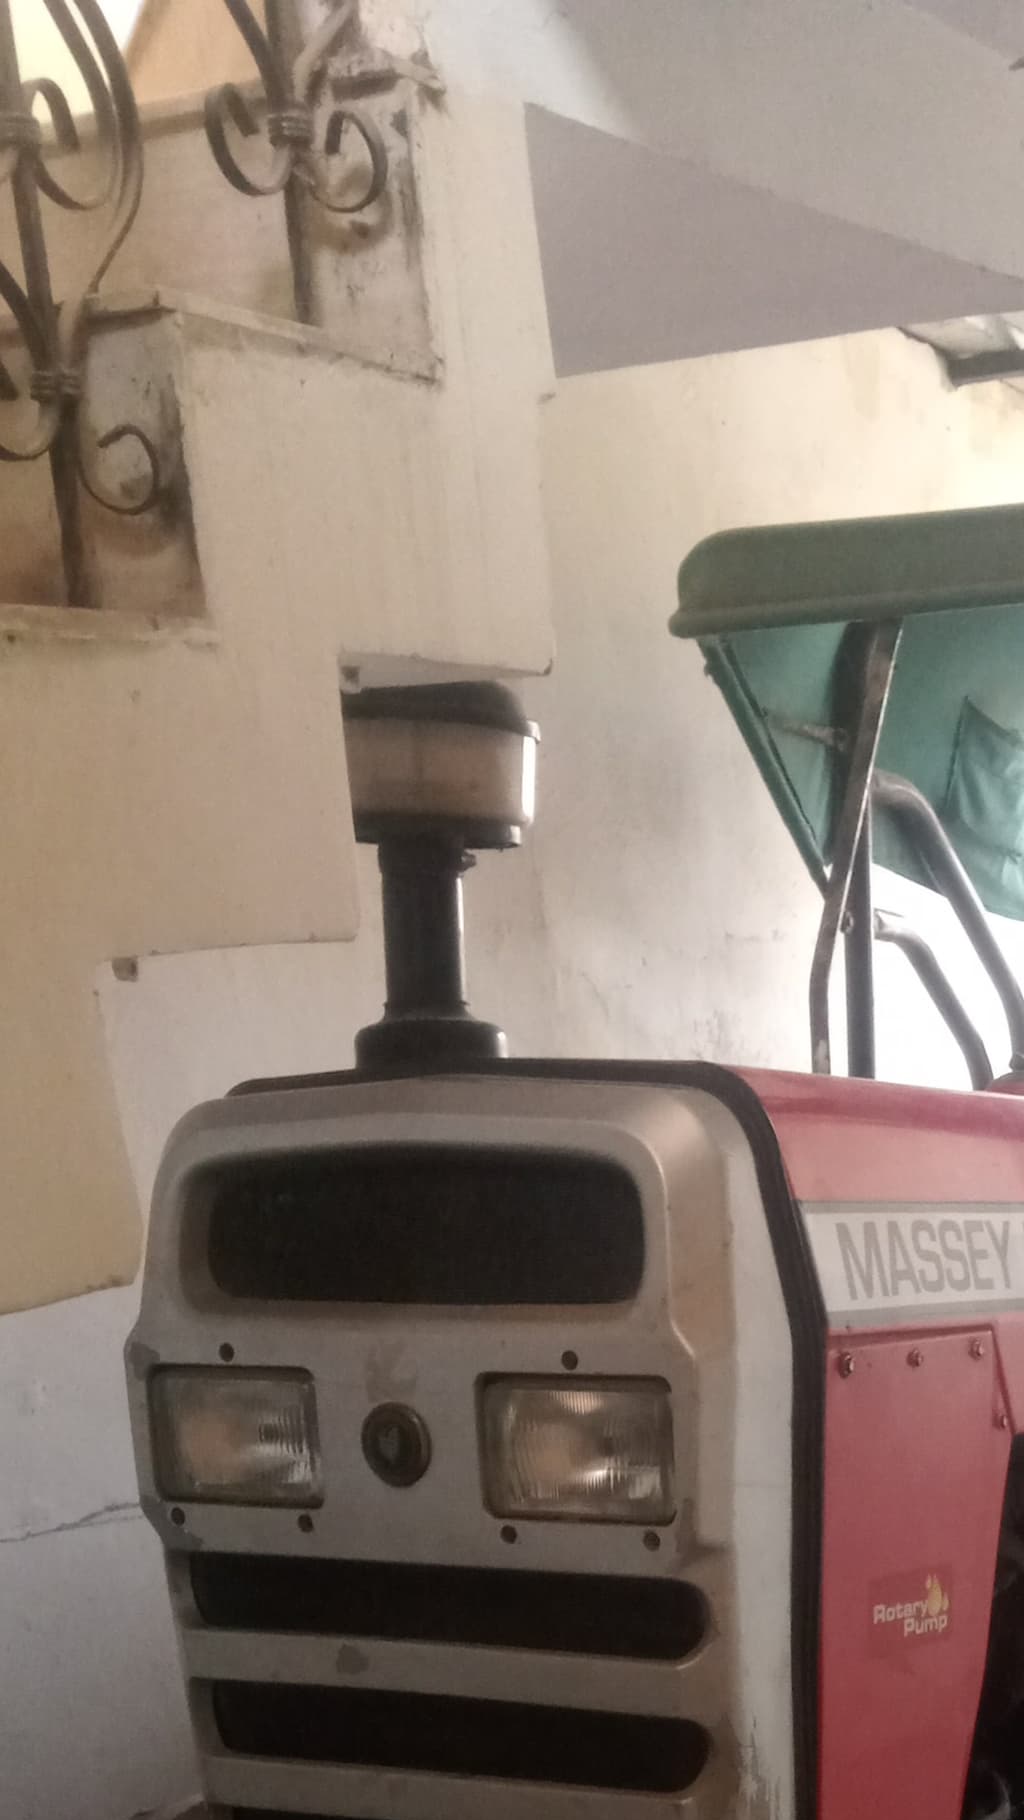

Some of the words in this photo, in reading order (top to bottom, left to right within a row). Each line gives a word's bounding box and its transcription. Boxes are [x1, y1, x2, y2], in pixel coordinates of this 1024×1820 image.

[835, 1219, 1013, 1301] MASSEY
[873, 1600, 929, 1624] Rotary
[903, 1615, 948, 1637] Pump
